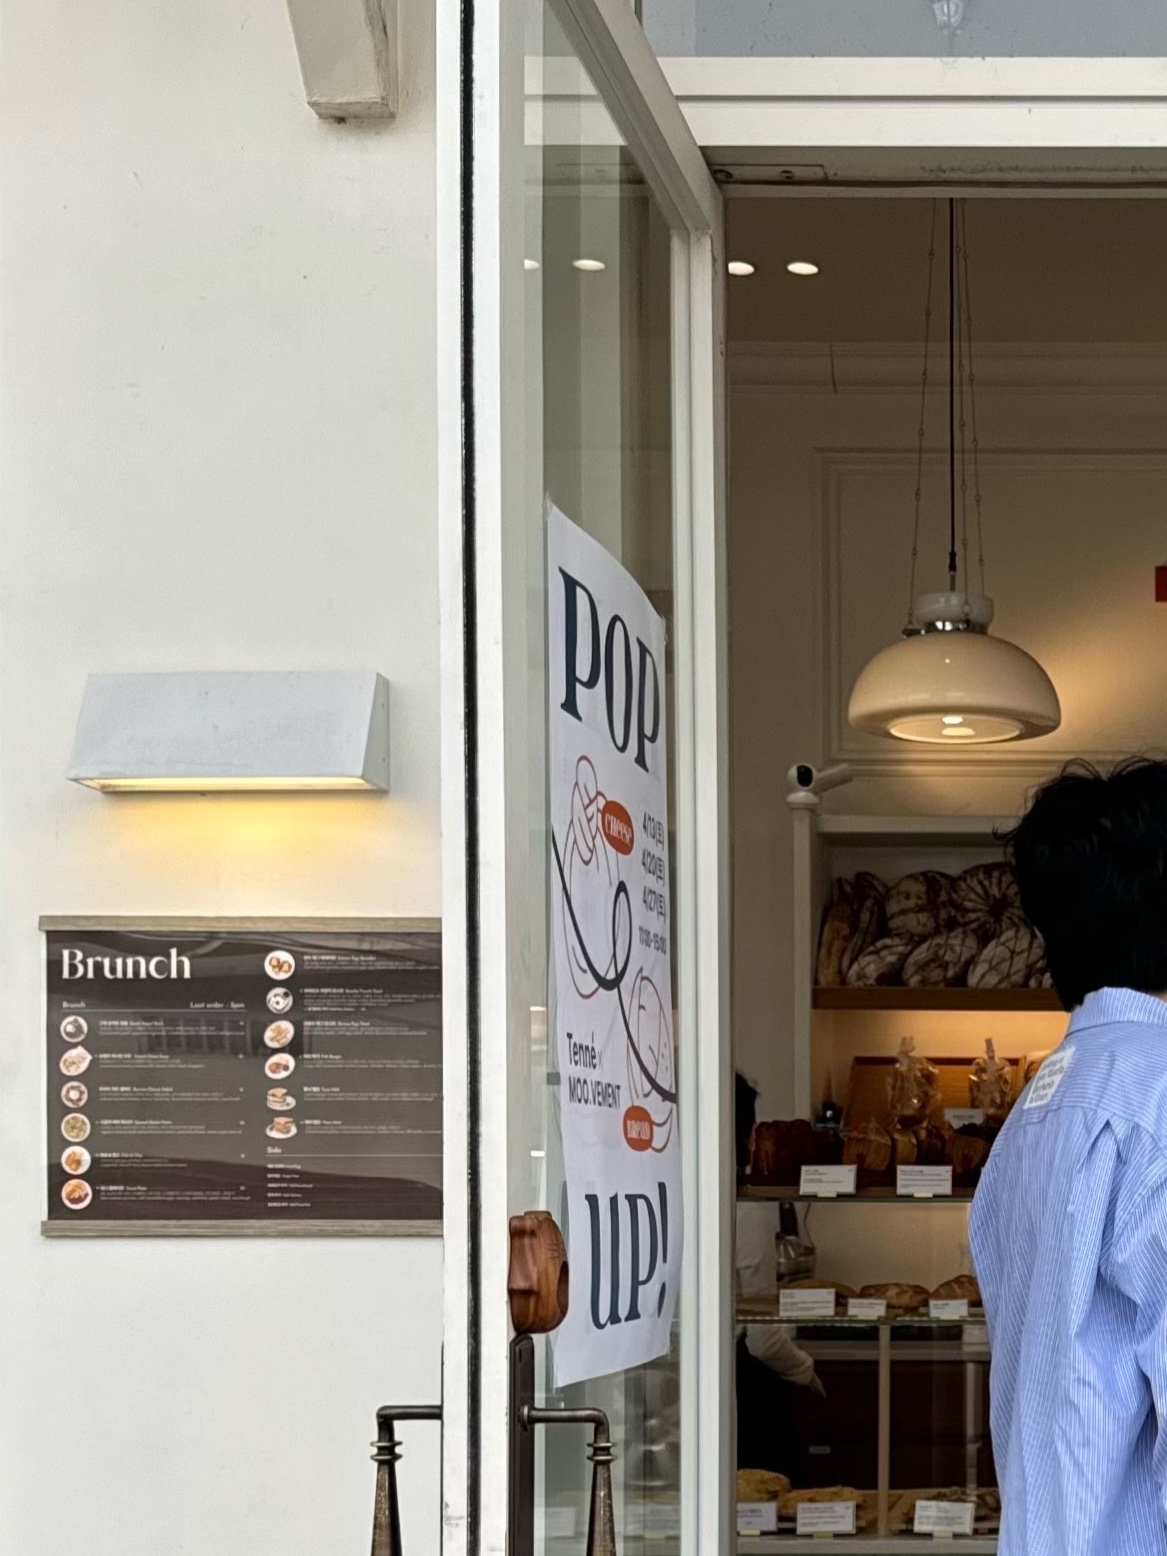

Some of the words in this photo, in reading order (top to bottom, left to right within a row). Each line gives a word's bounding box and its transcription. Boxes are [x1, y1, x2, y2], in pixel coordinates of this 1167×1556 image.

[558, 566, 660, 773] POP
[61, 948, 191, 980] Brunch
[566, 1031, 597, 1069] Tenné
[568, 1076, 621, 1109] MOO.VEMENT
[585, 1181, 668, 1331] UP!
